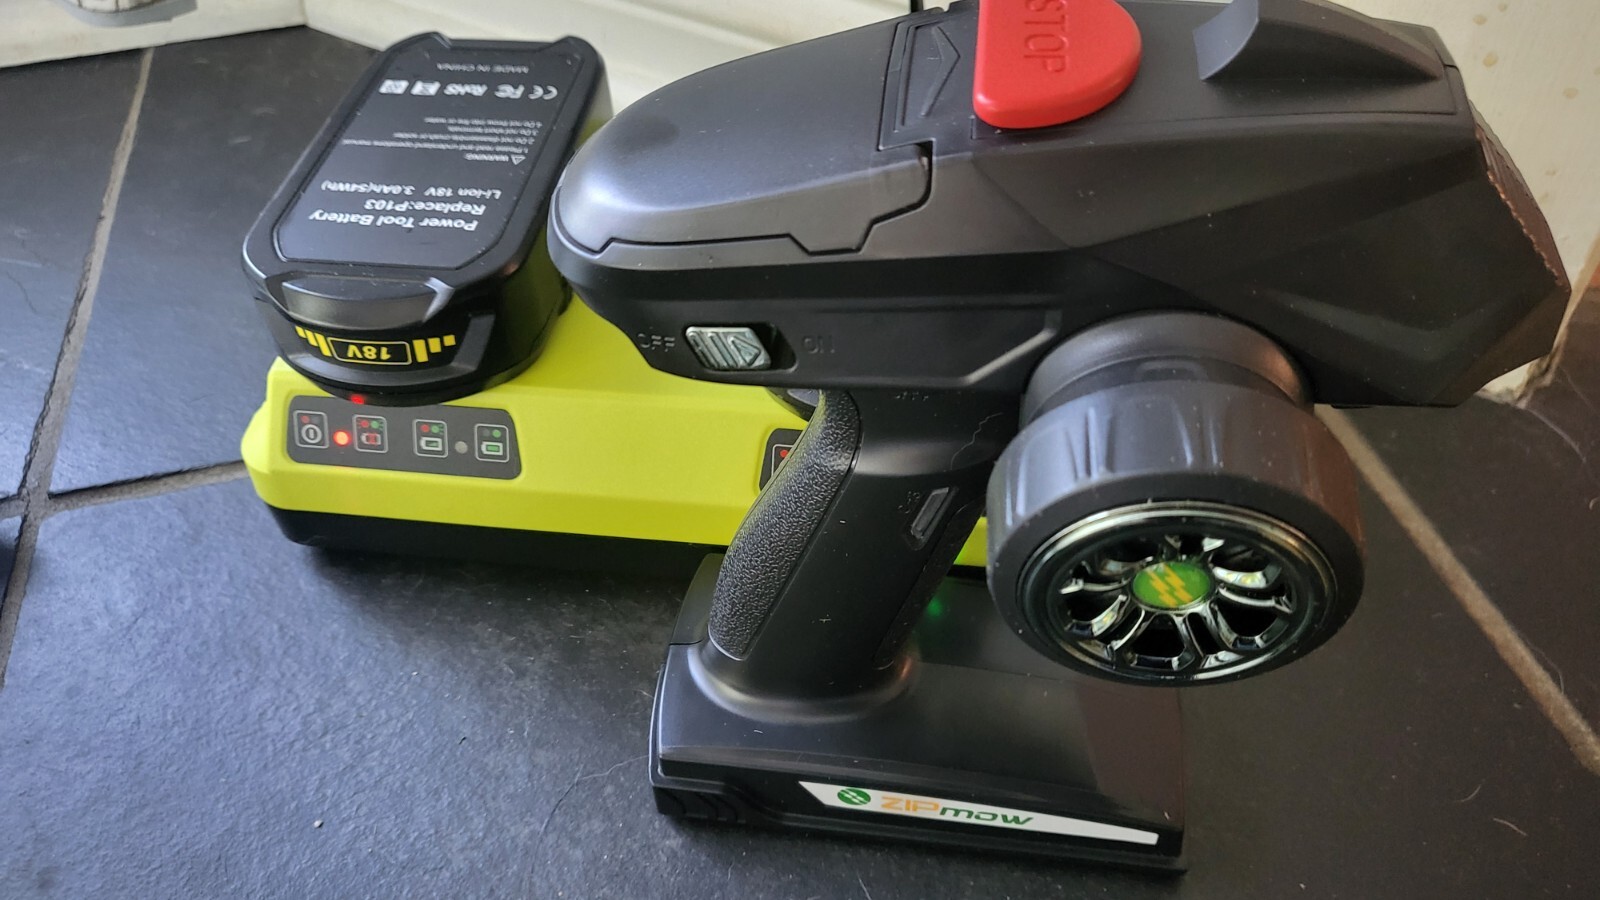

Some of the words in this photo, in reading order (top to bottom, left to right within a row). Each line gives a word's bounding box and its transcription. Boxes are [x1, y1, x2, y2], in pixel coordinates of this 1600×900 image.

[1023, 0, 1069, 73] STOP
[424, 186, 454, 197] 18V
[457, 187, 502, 200] Li-ion
[363, 198, 487, 216] Replace:P103
[308, 209, 375, 226] Battery
[375, 215, 415, 229] Tool
[418, 217, 479, 232] Power
[347, 344, 391, 361] 18V
